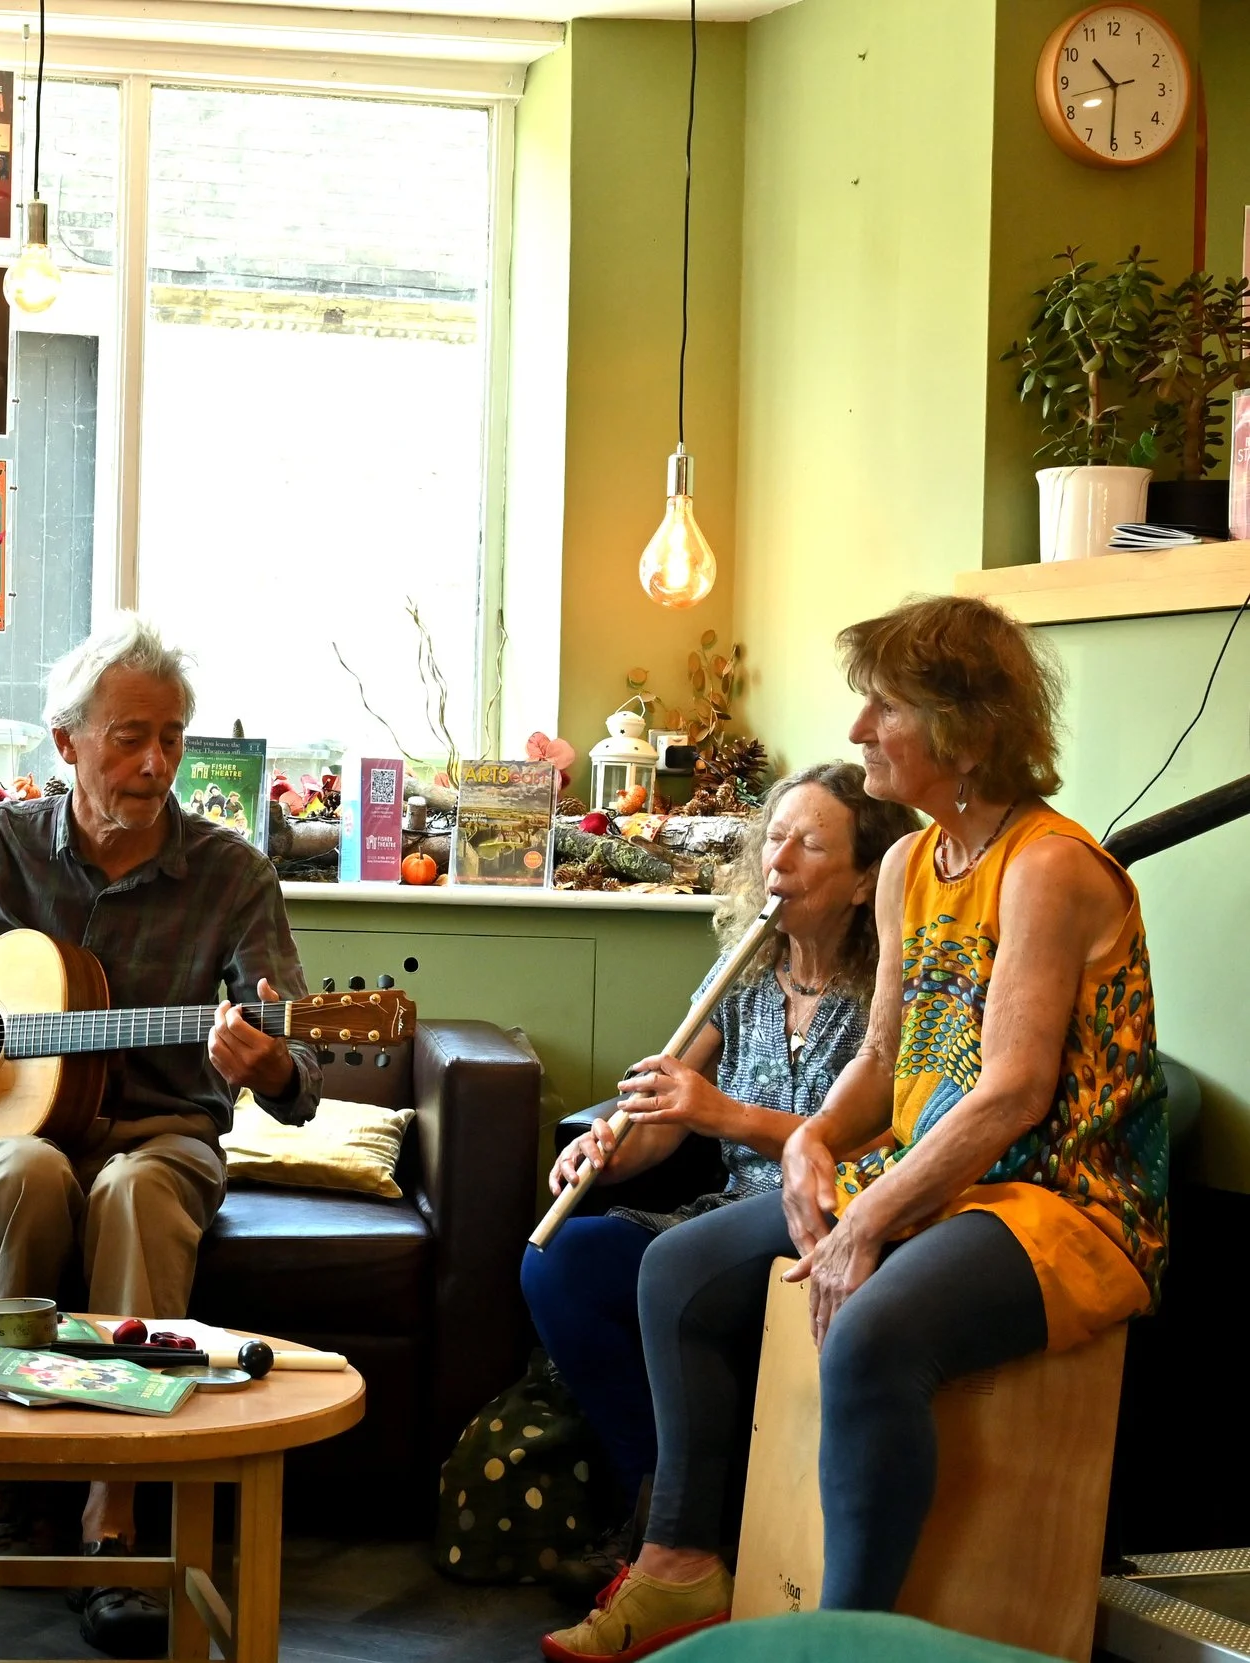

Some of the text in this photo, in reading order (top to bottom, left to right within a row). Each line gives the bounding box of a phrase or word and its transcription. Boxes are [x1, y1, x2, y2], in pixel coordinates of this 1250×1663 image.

[1083, 28, 1095, 42] 11
[1107, 22, 1120, 36] 12
[1136, 31, 1140, 45] 1
[1065, 48, 1078, 62] 10
[1152, 54, 1160, 68] 2
[1061, 76, 1069, 90] 9
[1158, 83, 1165, 97] 3
[1067, 106, 1074, 120] 8
[1151, 112, 1159, 125] 4
[1086, 128, 1093, 142] 7
[1134, 131, 1141, 144] 5
[1110, 138, 1118, 151] 6
